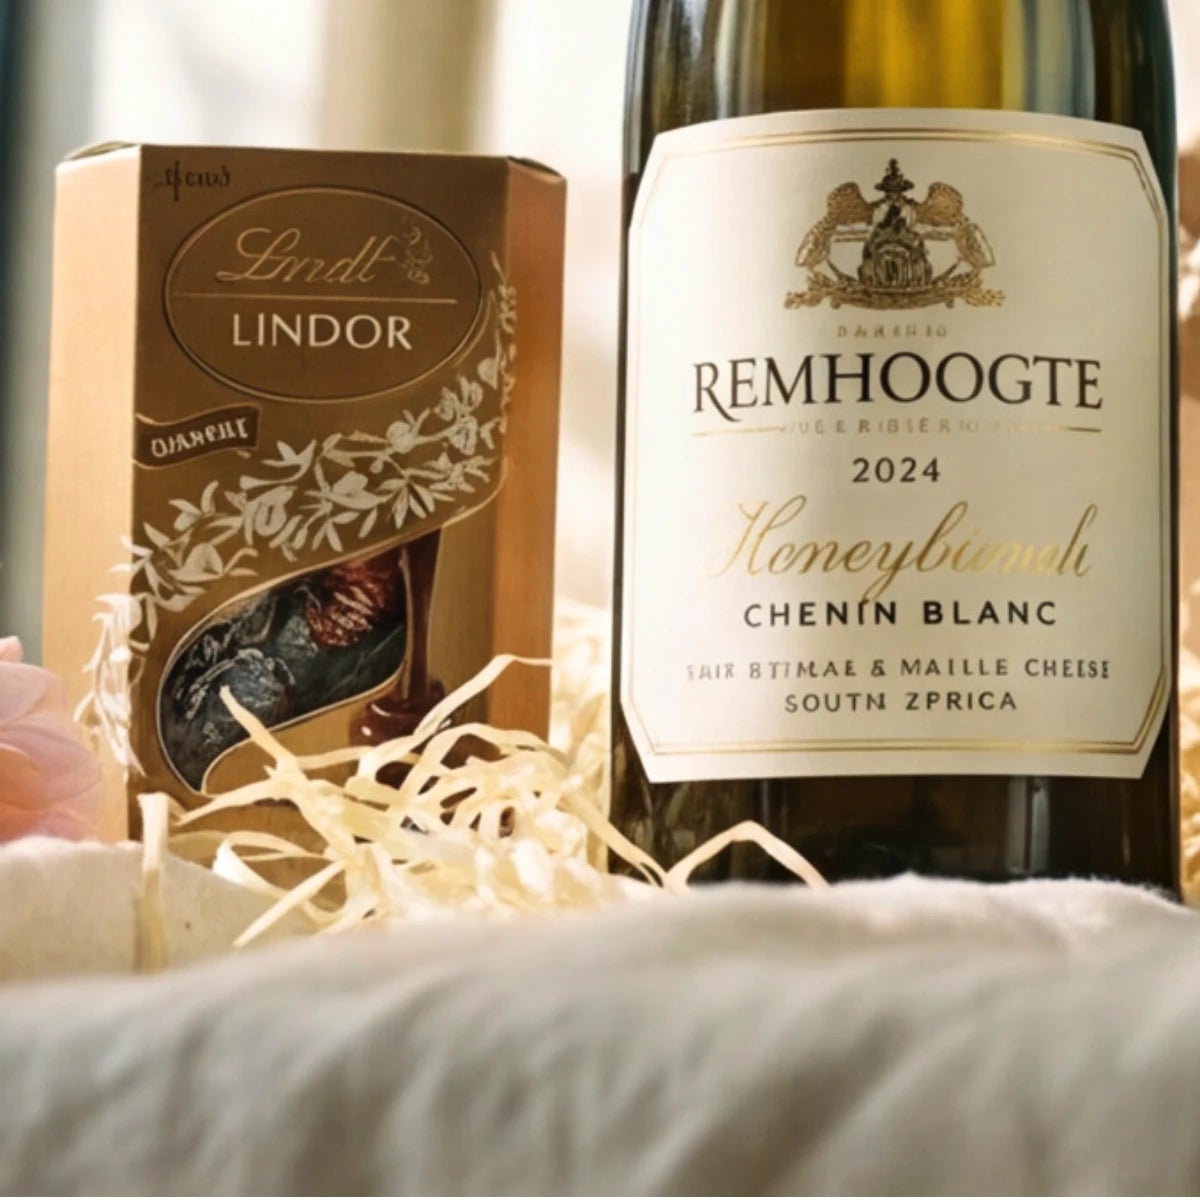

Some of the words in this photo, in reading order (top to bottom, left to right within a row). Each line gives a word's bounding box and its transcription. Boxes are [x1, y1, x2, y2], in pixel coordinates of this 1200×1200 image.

[232, 312, 412, 350] LINDOR
[693, 351, 1103, 422] REMHOOGTE
[851, 456, 941, 484] 2024
[744, 601, 897, 628] CHENIN
[922, 600, 1057, 626] BLANC
[901, 658, 1009, 677] MAILLE
[905, 691, 1017, 711] ZPRICA
